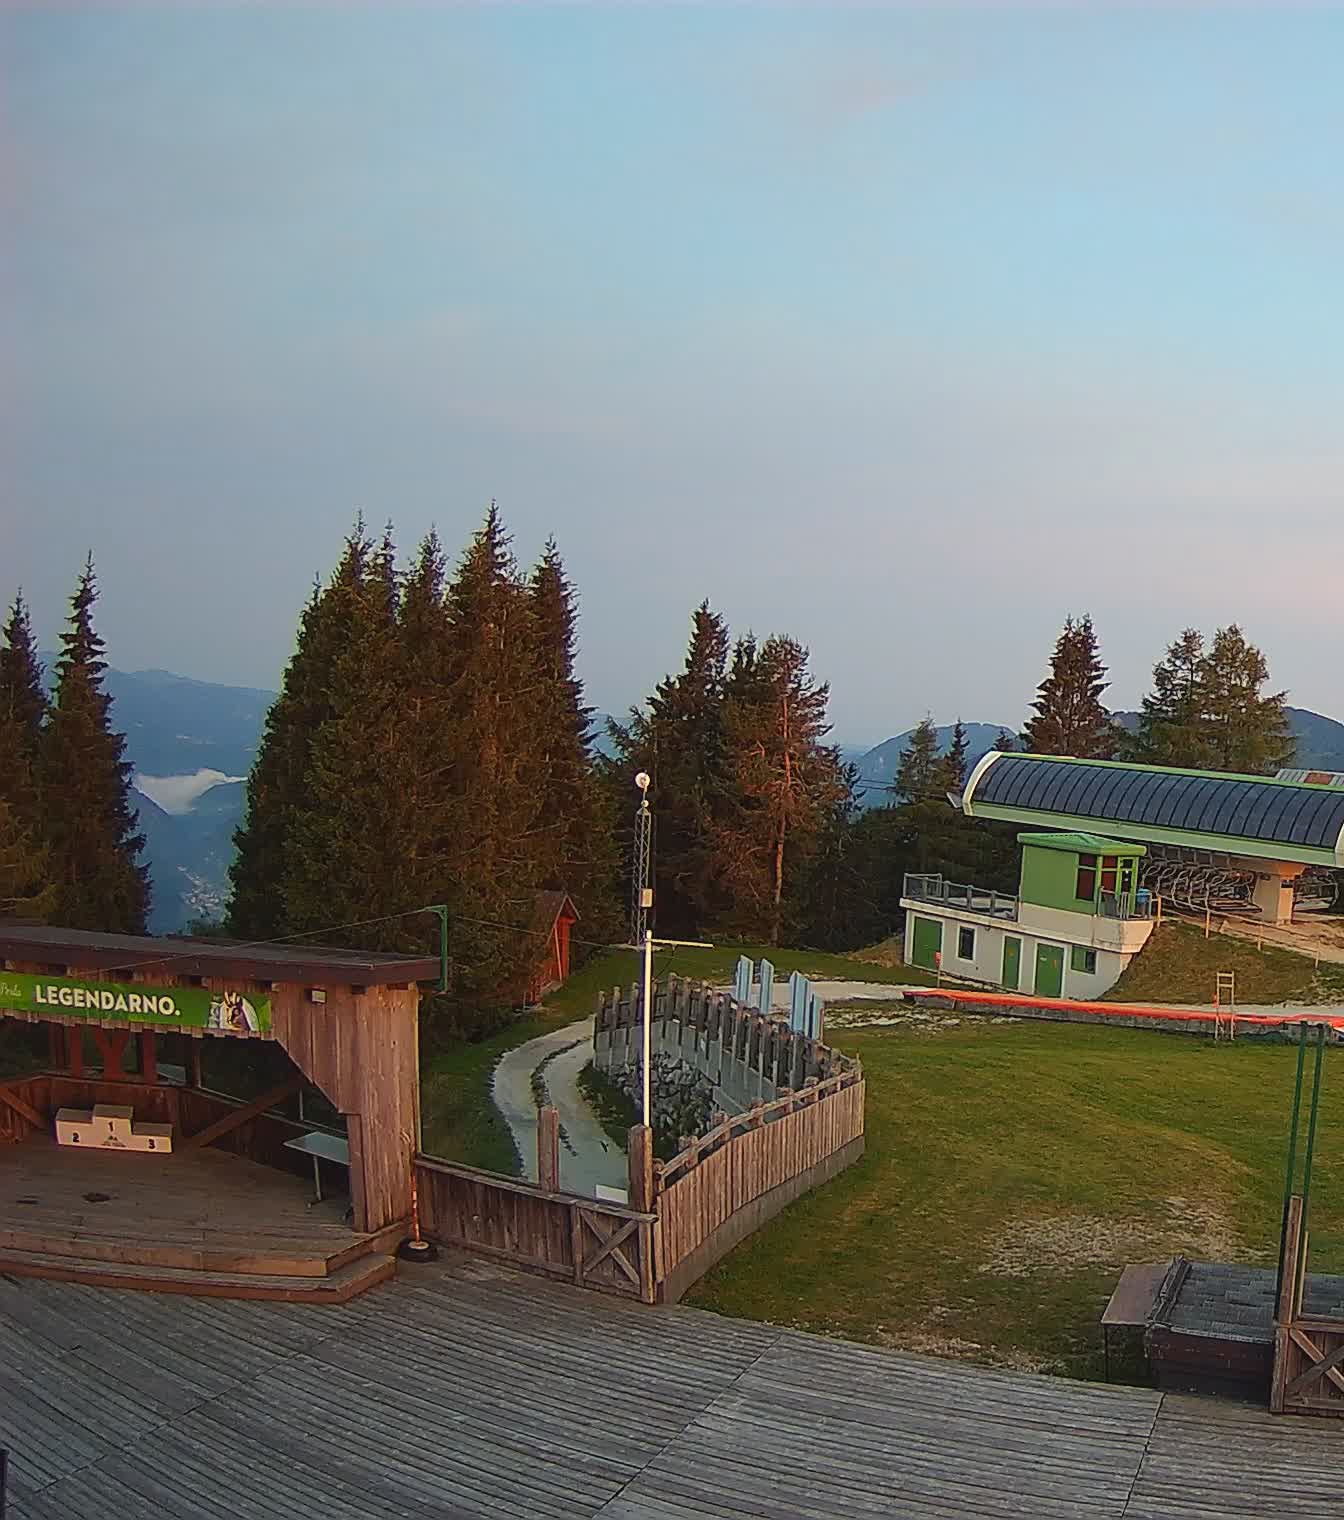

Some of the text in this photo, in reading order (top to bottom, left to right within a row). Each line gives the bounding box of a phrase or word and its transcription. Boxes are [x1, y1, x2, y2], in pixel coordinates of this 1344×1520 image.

[35, 984, 181, 1016] LEGENDARNO.
[107, 1121, 114, 1132] 1
[72, 1132, 80, 1143] 2
[148, 1138, 156, 1150] 3
